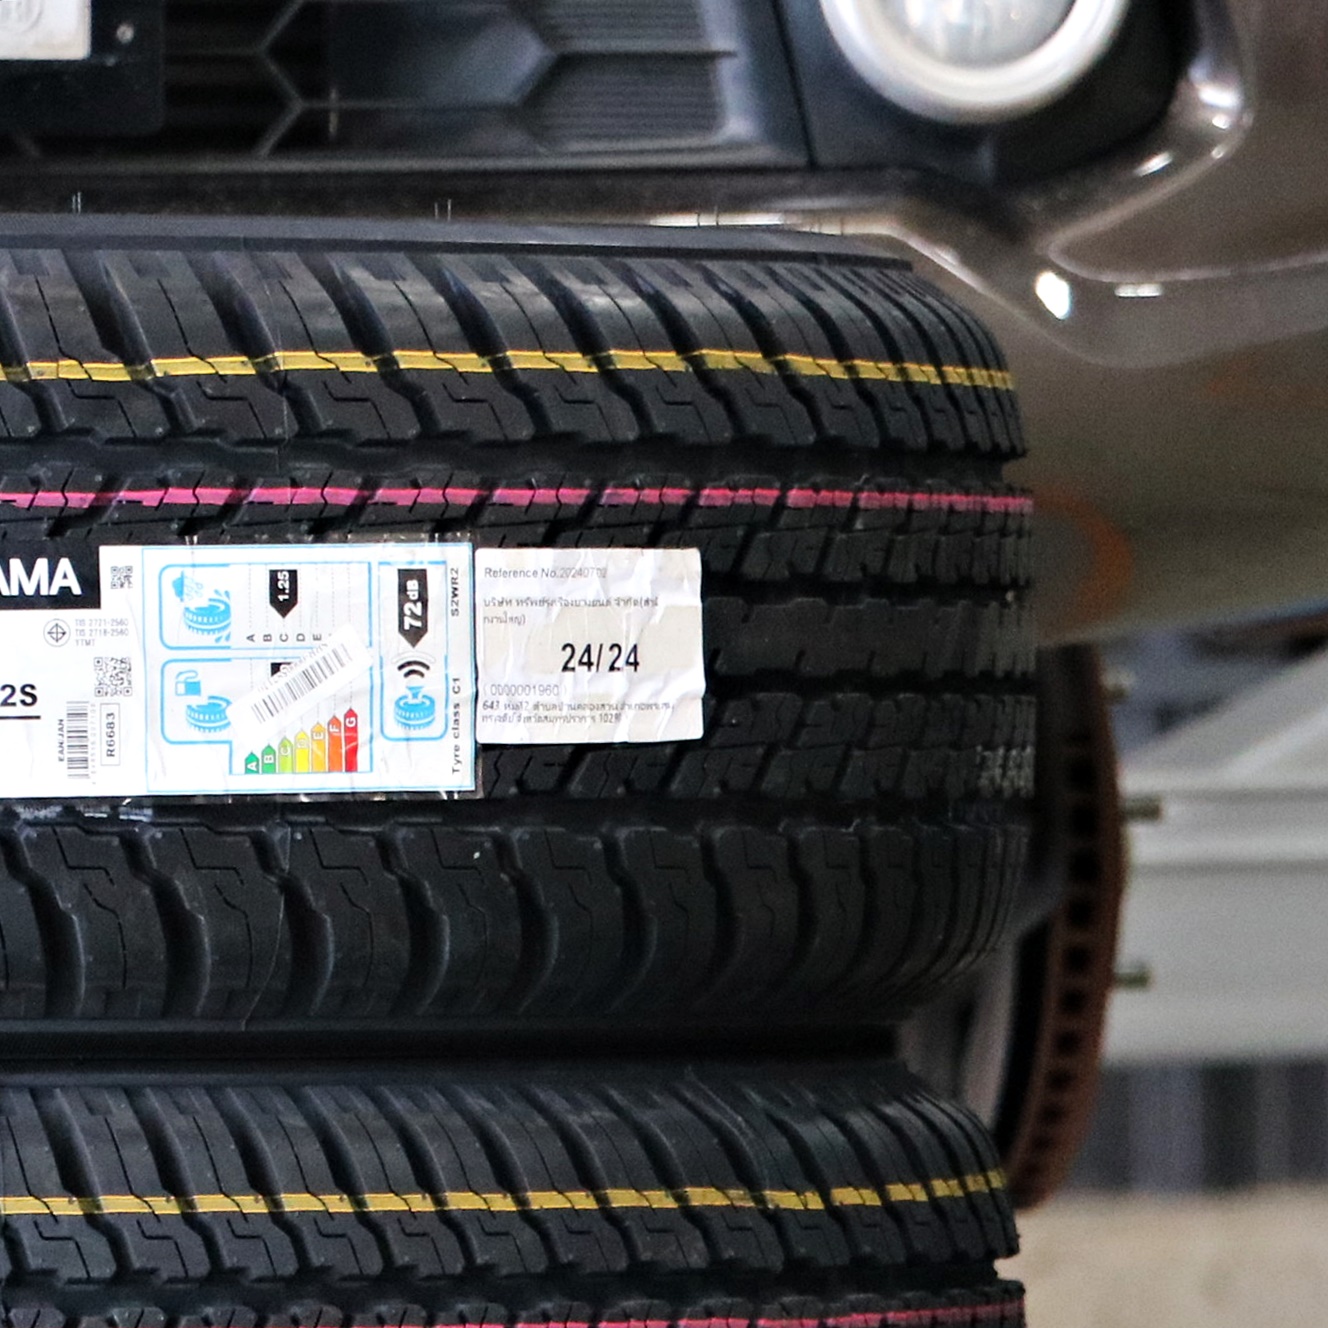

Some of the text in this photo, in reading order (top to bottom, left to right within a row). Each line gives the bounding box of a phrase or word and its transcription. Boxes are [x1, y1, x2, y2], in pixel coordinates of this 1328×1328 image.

[484, 567, 538, 578] Reference
[277, 571, 290, 602] 1.25
[451, 567, 459, 617] S2WR2
[247, 633, 256, 642] A
[263, 633, 272, 642] B
[279, 633, 289, 642] C
[296, 633, 305, 642] D
[313, 633, 322, 642] E
[346, 717, 355, 727] G
[452, 677, 462, 774] Tyre class C1
[106, 712, 115, 758] R6683
[313, 730, 323, 739] E
[264, 754, 273, 764] B
[247, 761, 257, 771] A
